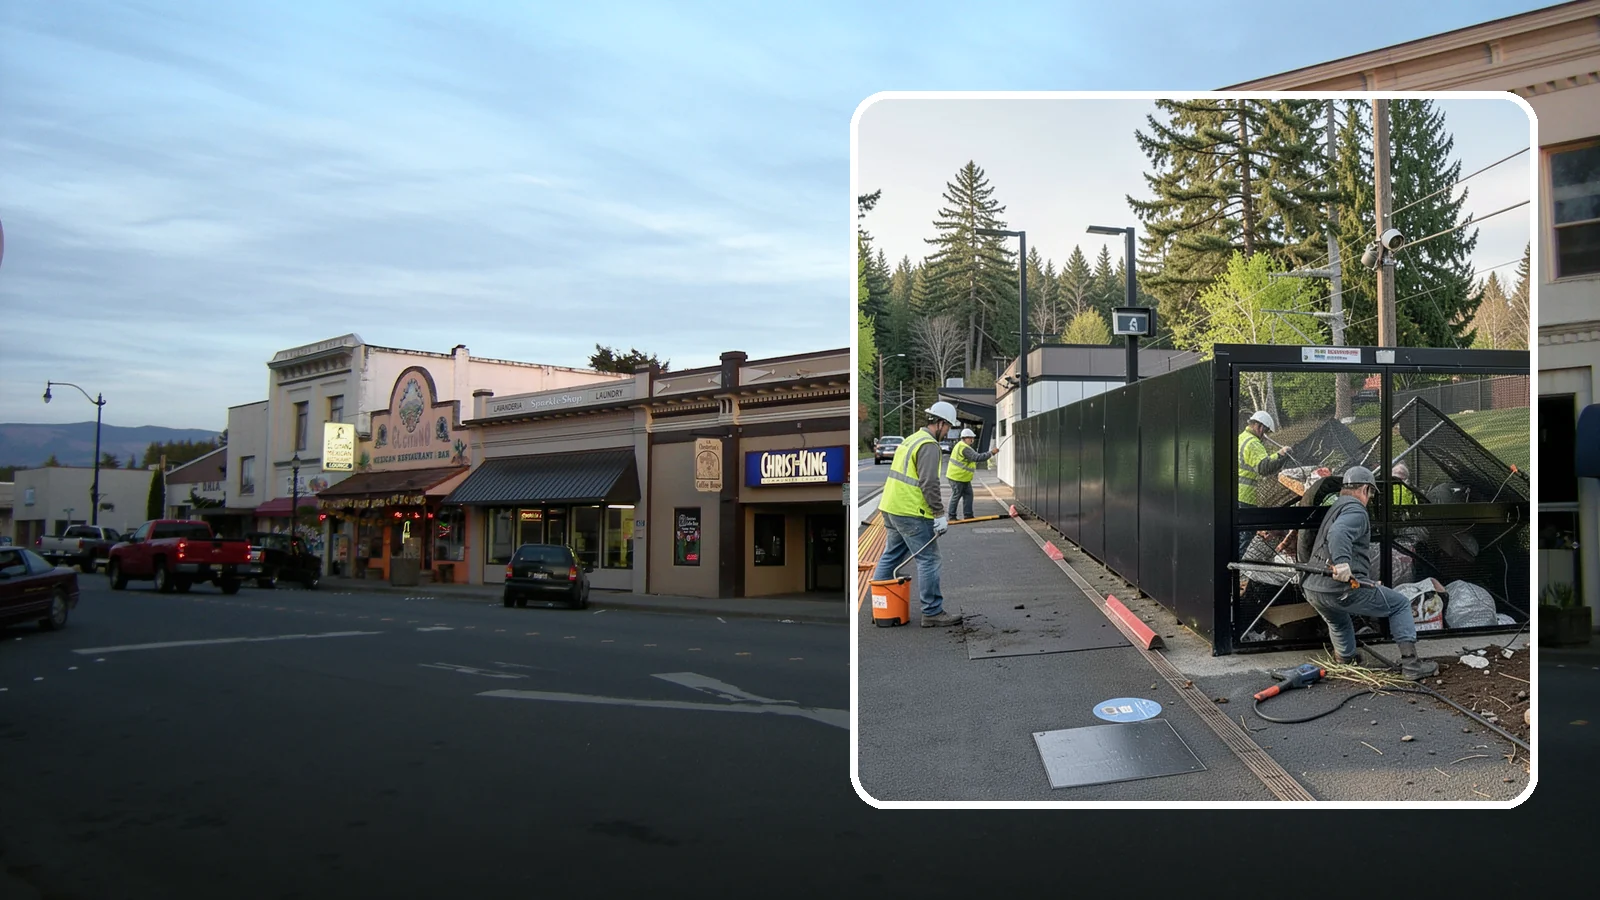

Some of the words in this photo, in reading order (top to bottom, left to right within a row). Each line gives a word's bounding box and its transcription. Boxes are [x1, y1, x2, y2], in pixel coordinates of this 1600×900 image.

[595, 389, 624, 400] LAUNDRY
[530, 398, 561, 408] Sparkle
[562, 394, 582, 404] Shop
[493, 402, 522, 413] LAVANDERIA
[397, 451, 434, 462] RESTAURANT
[761, 452, 797, 478] CHRIST
[799, 450, 827, 477] KING
